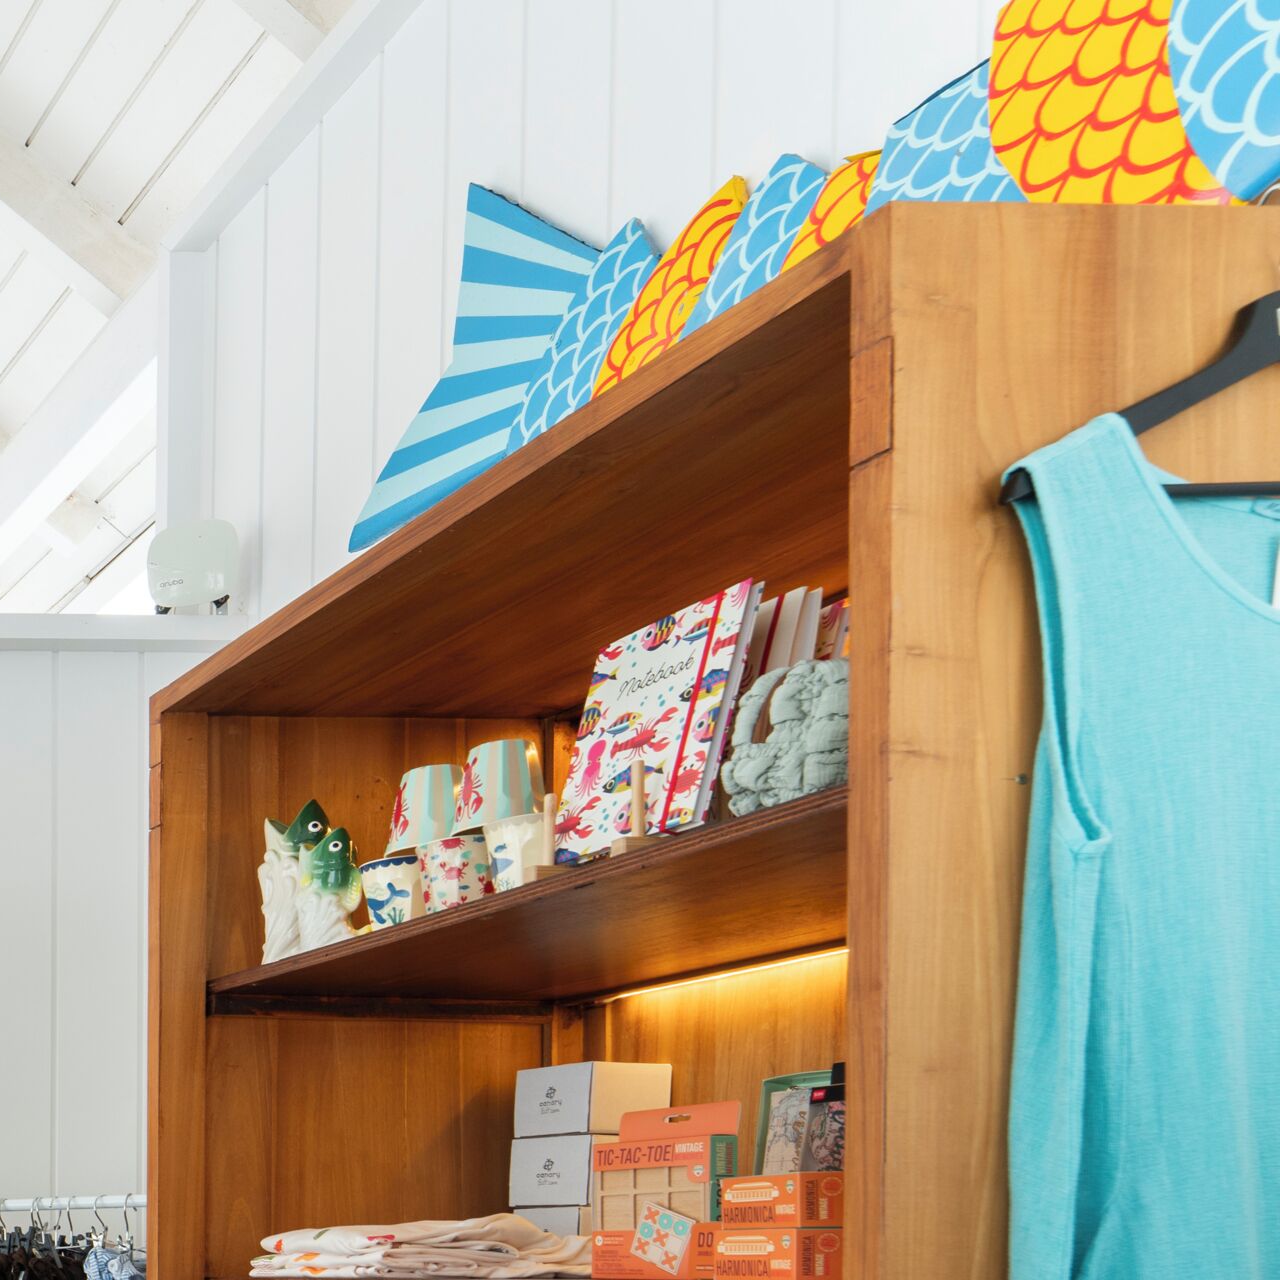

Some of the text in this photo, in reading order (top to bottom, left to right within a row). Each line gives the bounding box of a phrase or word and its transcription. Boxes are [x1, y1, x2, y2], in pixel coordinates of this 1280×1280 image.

[160, 578, 184, 588] aruba
[597, 1144, 672, 1167] TIC-TAC-TOE
[675, 1142, 704, 1153] VINTAGE
[806, 1179, 817, 1221] HARMONICA
[724, 1205, 774, 1224] HARMONICA
[697, 1231, 714, 1248] DO
[802, 1235, 813, 1277] HARMONICA
[716, 1259, 768, 1277] HARMONICA
